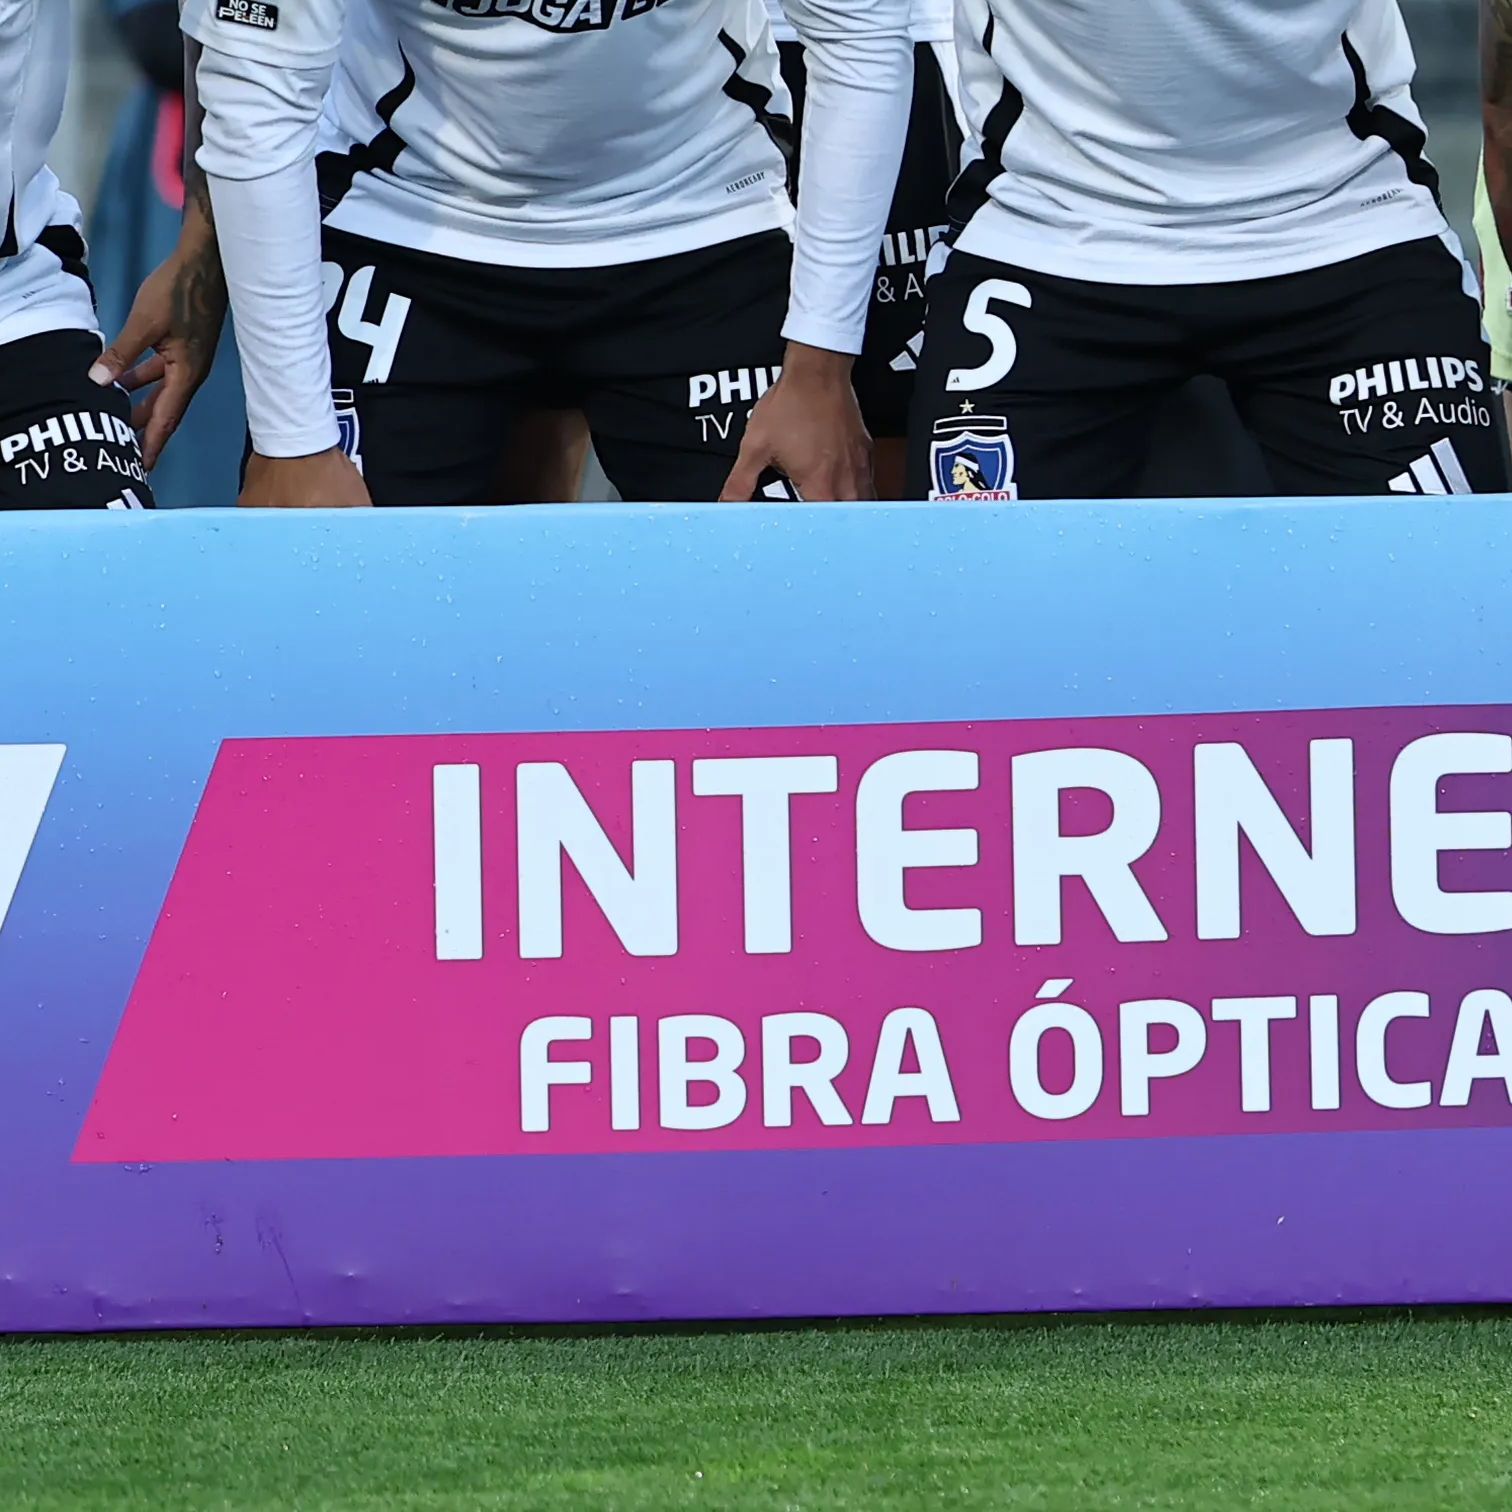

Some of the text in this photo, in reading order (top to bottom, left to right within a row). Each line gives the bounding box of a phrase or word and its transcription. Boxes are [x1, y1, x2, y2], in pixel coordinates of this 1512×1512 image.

[218, 7, 275, 29] PELEEN
[251, 3, 267, 16] SE
[725, 171, 766, 195] AEROREADY
[945, 278, 1033, 392] 5
[1328, 356, 1484, 406] PHILIPS
[694, 412, 734, 442] TV
[1339, 396, 1491, 435] TV & Audio
[14, 452, 50, 485] TV
[62, 448, 88, 473] &
[517, 1006, 961, 1136] FIBRA
